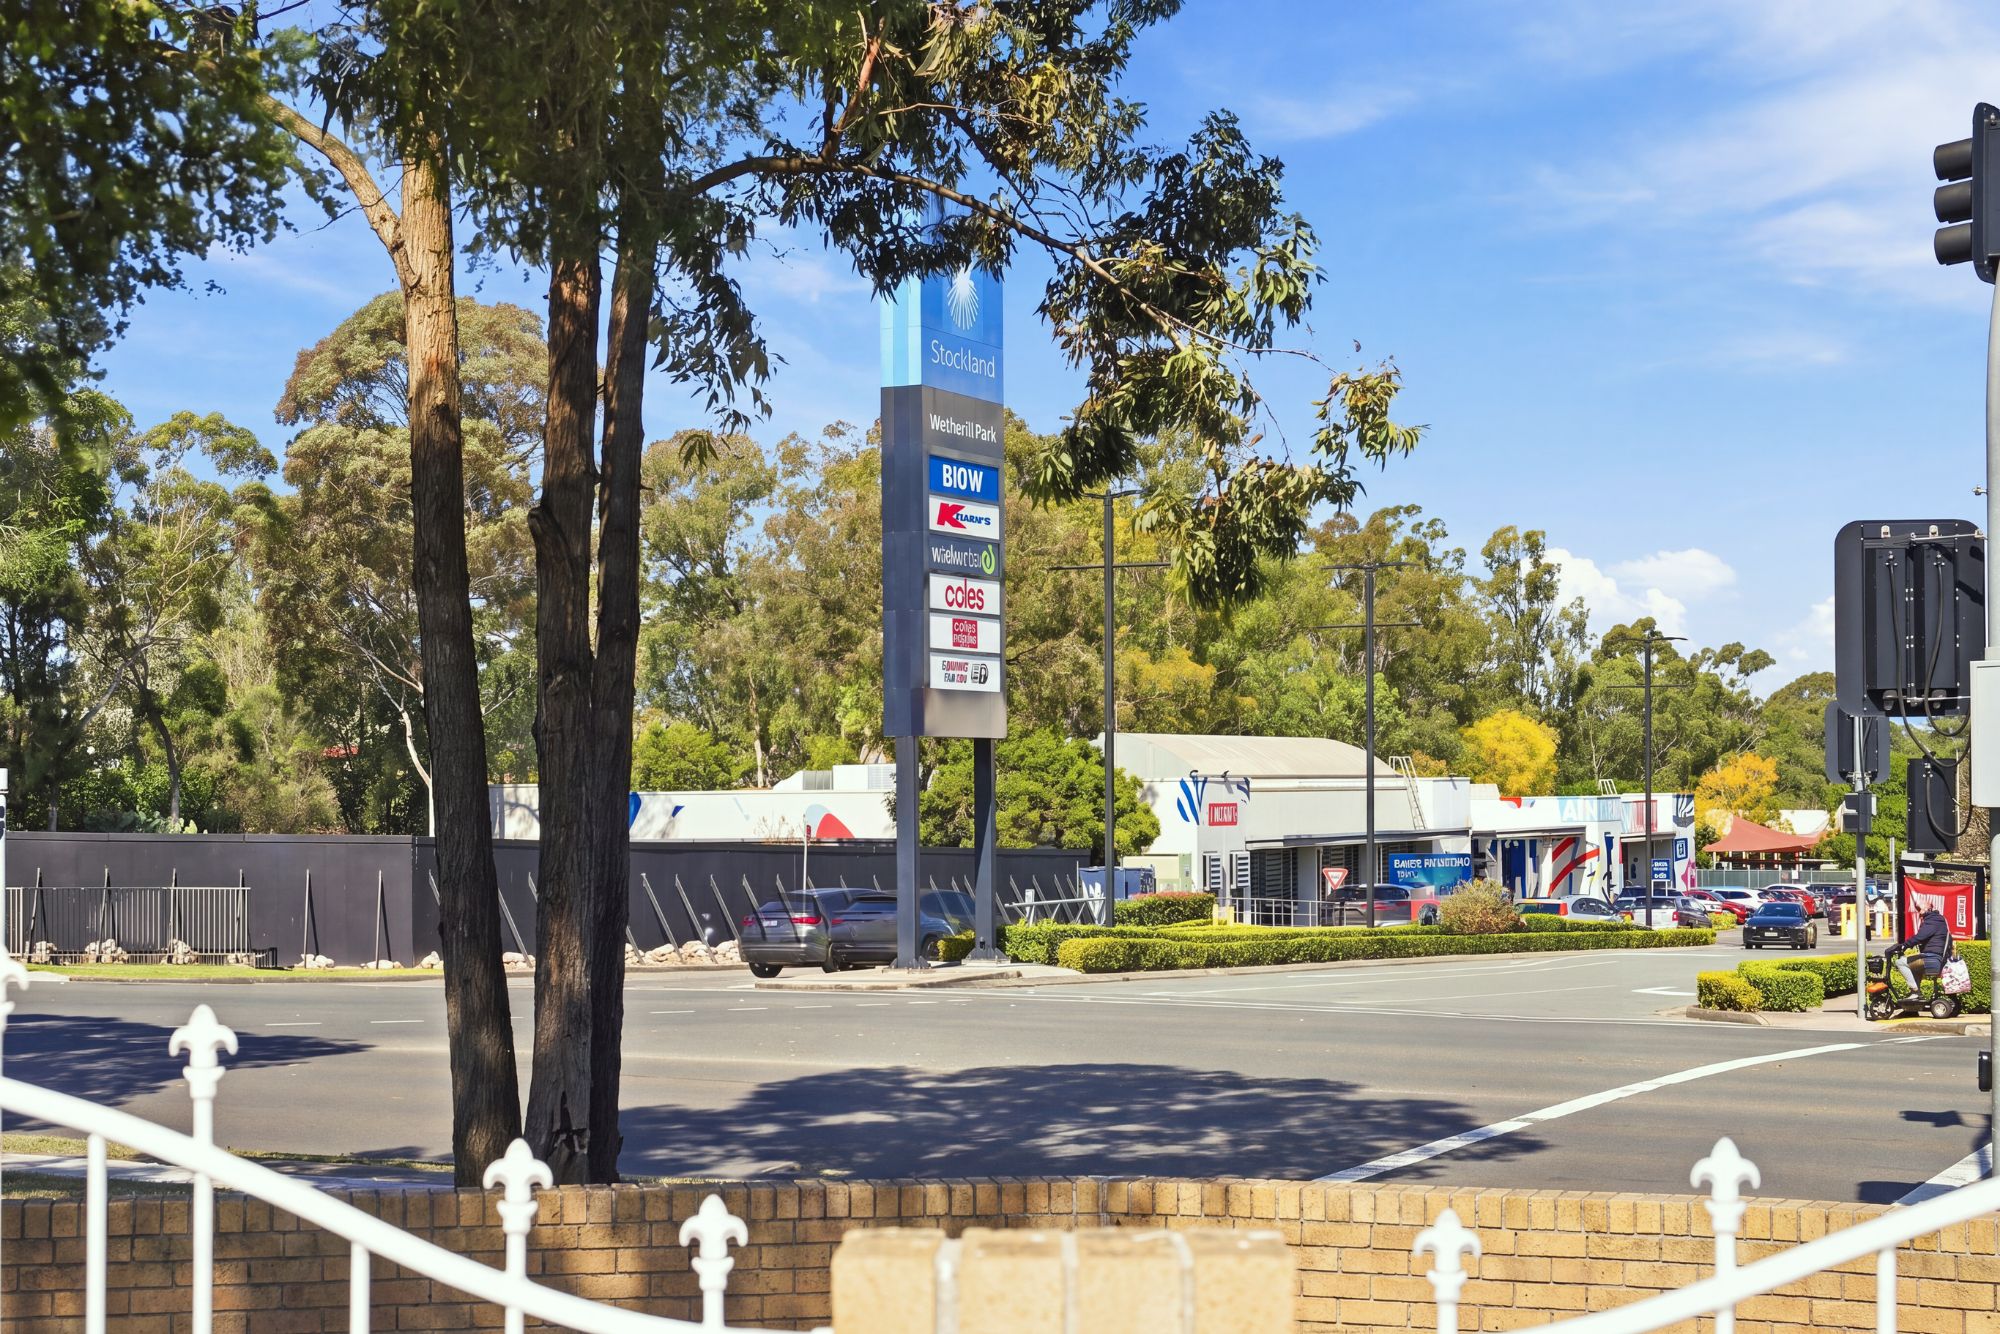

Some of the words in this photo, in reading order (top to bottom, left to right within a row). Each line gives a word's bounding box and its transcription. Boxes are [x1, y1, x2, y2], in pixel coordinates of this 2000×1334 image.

[931, 339, 995, 379] Stockland
[929, 413, 974, 440] Wetherill
[975, 423, 997, 443] Park
[945, 576, 985, 611] coles
